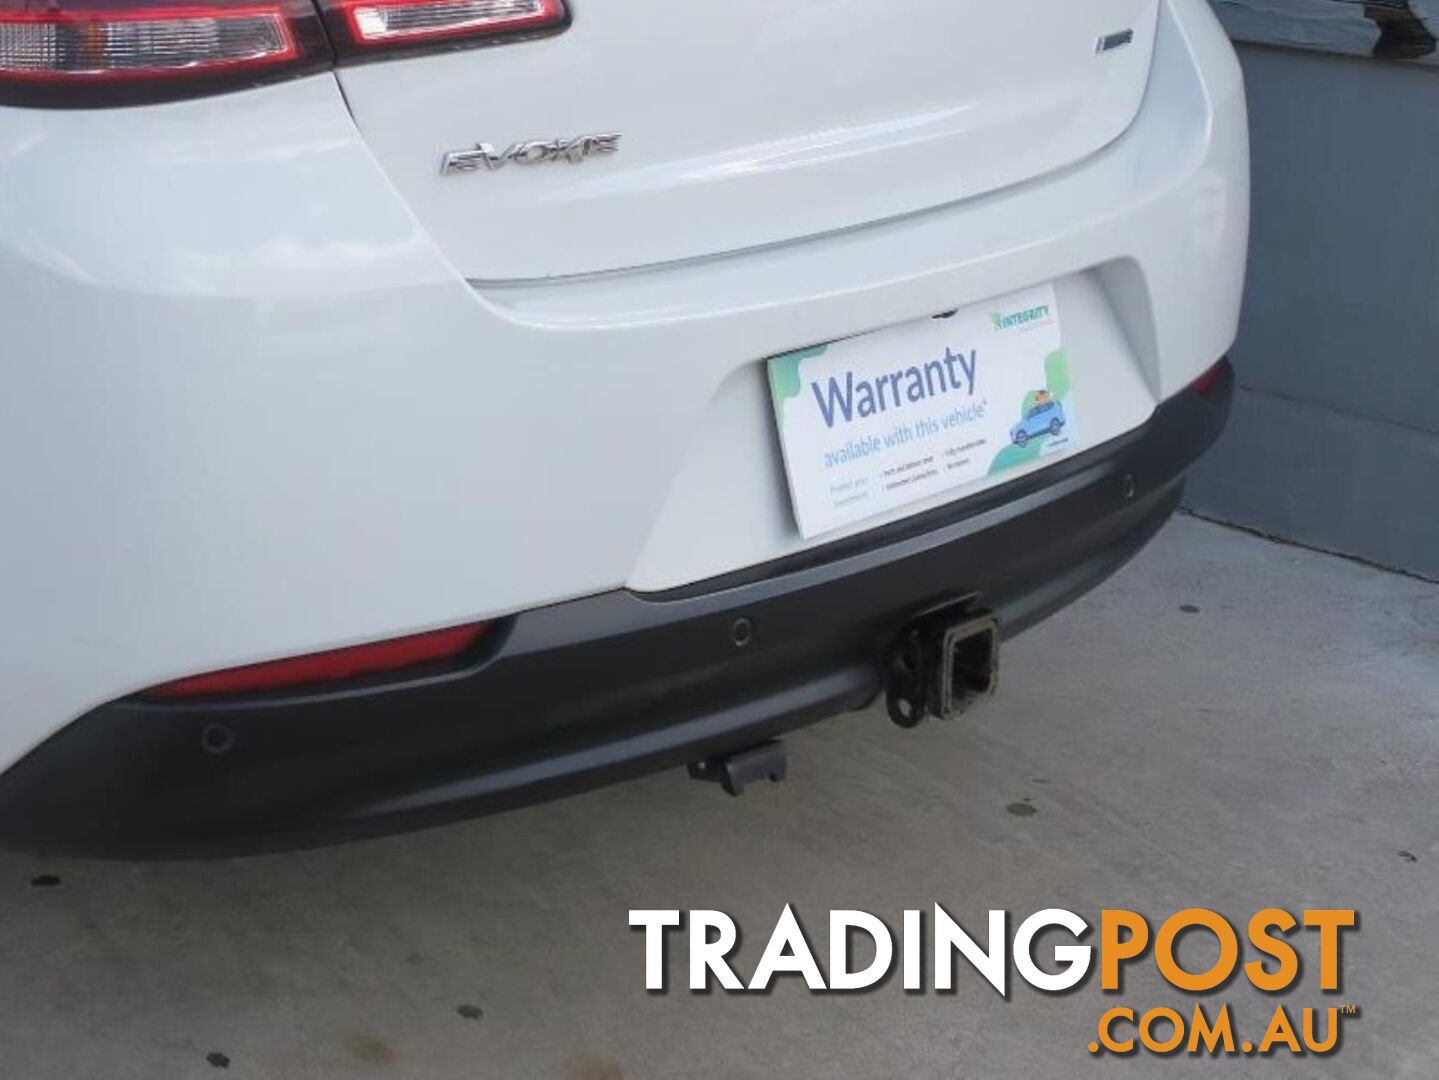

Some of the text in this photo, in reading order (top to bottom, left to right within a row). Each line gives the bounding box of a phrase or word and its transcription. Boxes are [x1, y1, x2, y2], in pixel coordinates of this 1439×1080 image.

[811, 346, 978, 429] Warranty
[824, 435, 881, 469] available
[884, 425, 913, 448] with
[915, 418, 940, 439] this
